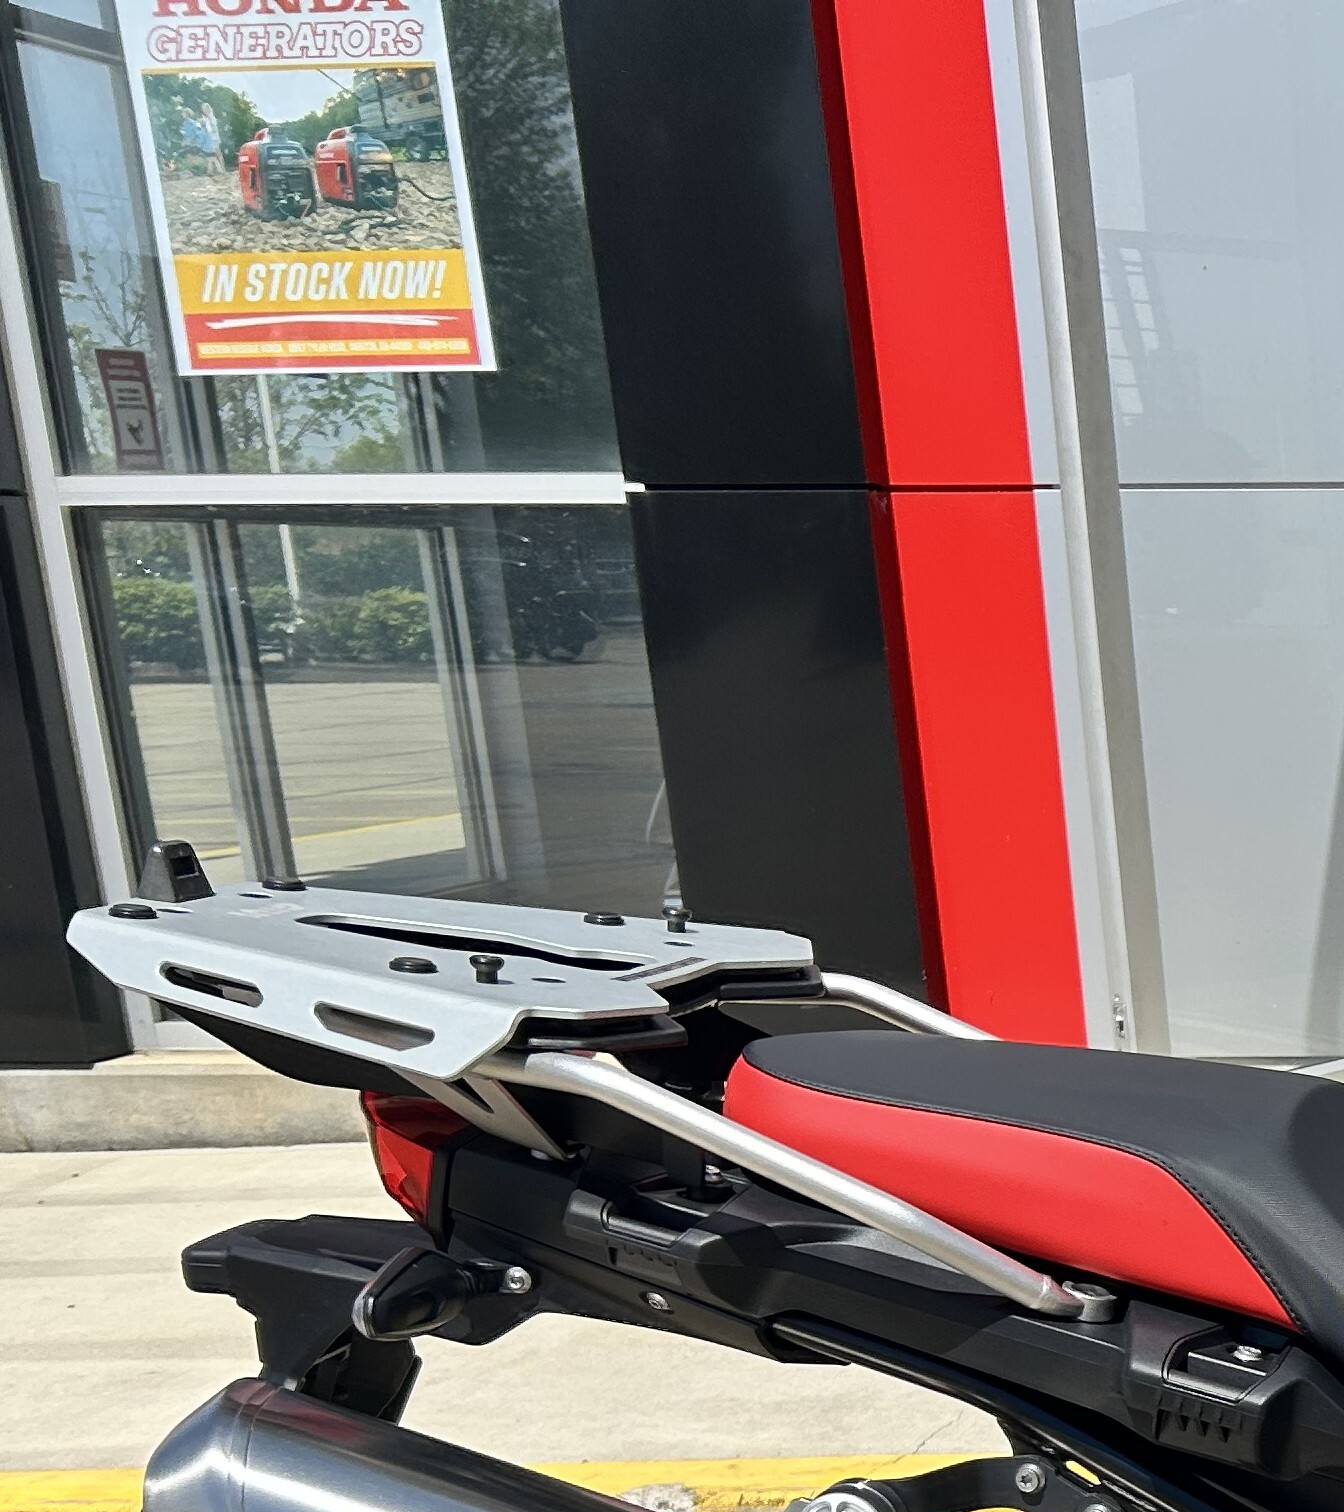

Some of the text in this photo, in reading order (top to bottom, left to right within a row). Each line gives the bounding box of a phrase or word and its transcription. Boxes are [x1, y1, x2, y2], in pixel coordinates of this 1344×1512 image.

[147, 19, 424, 62] GENERATORS
[200, 259, 447, 303] IN STOCK NOW!
